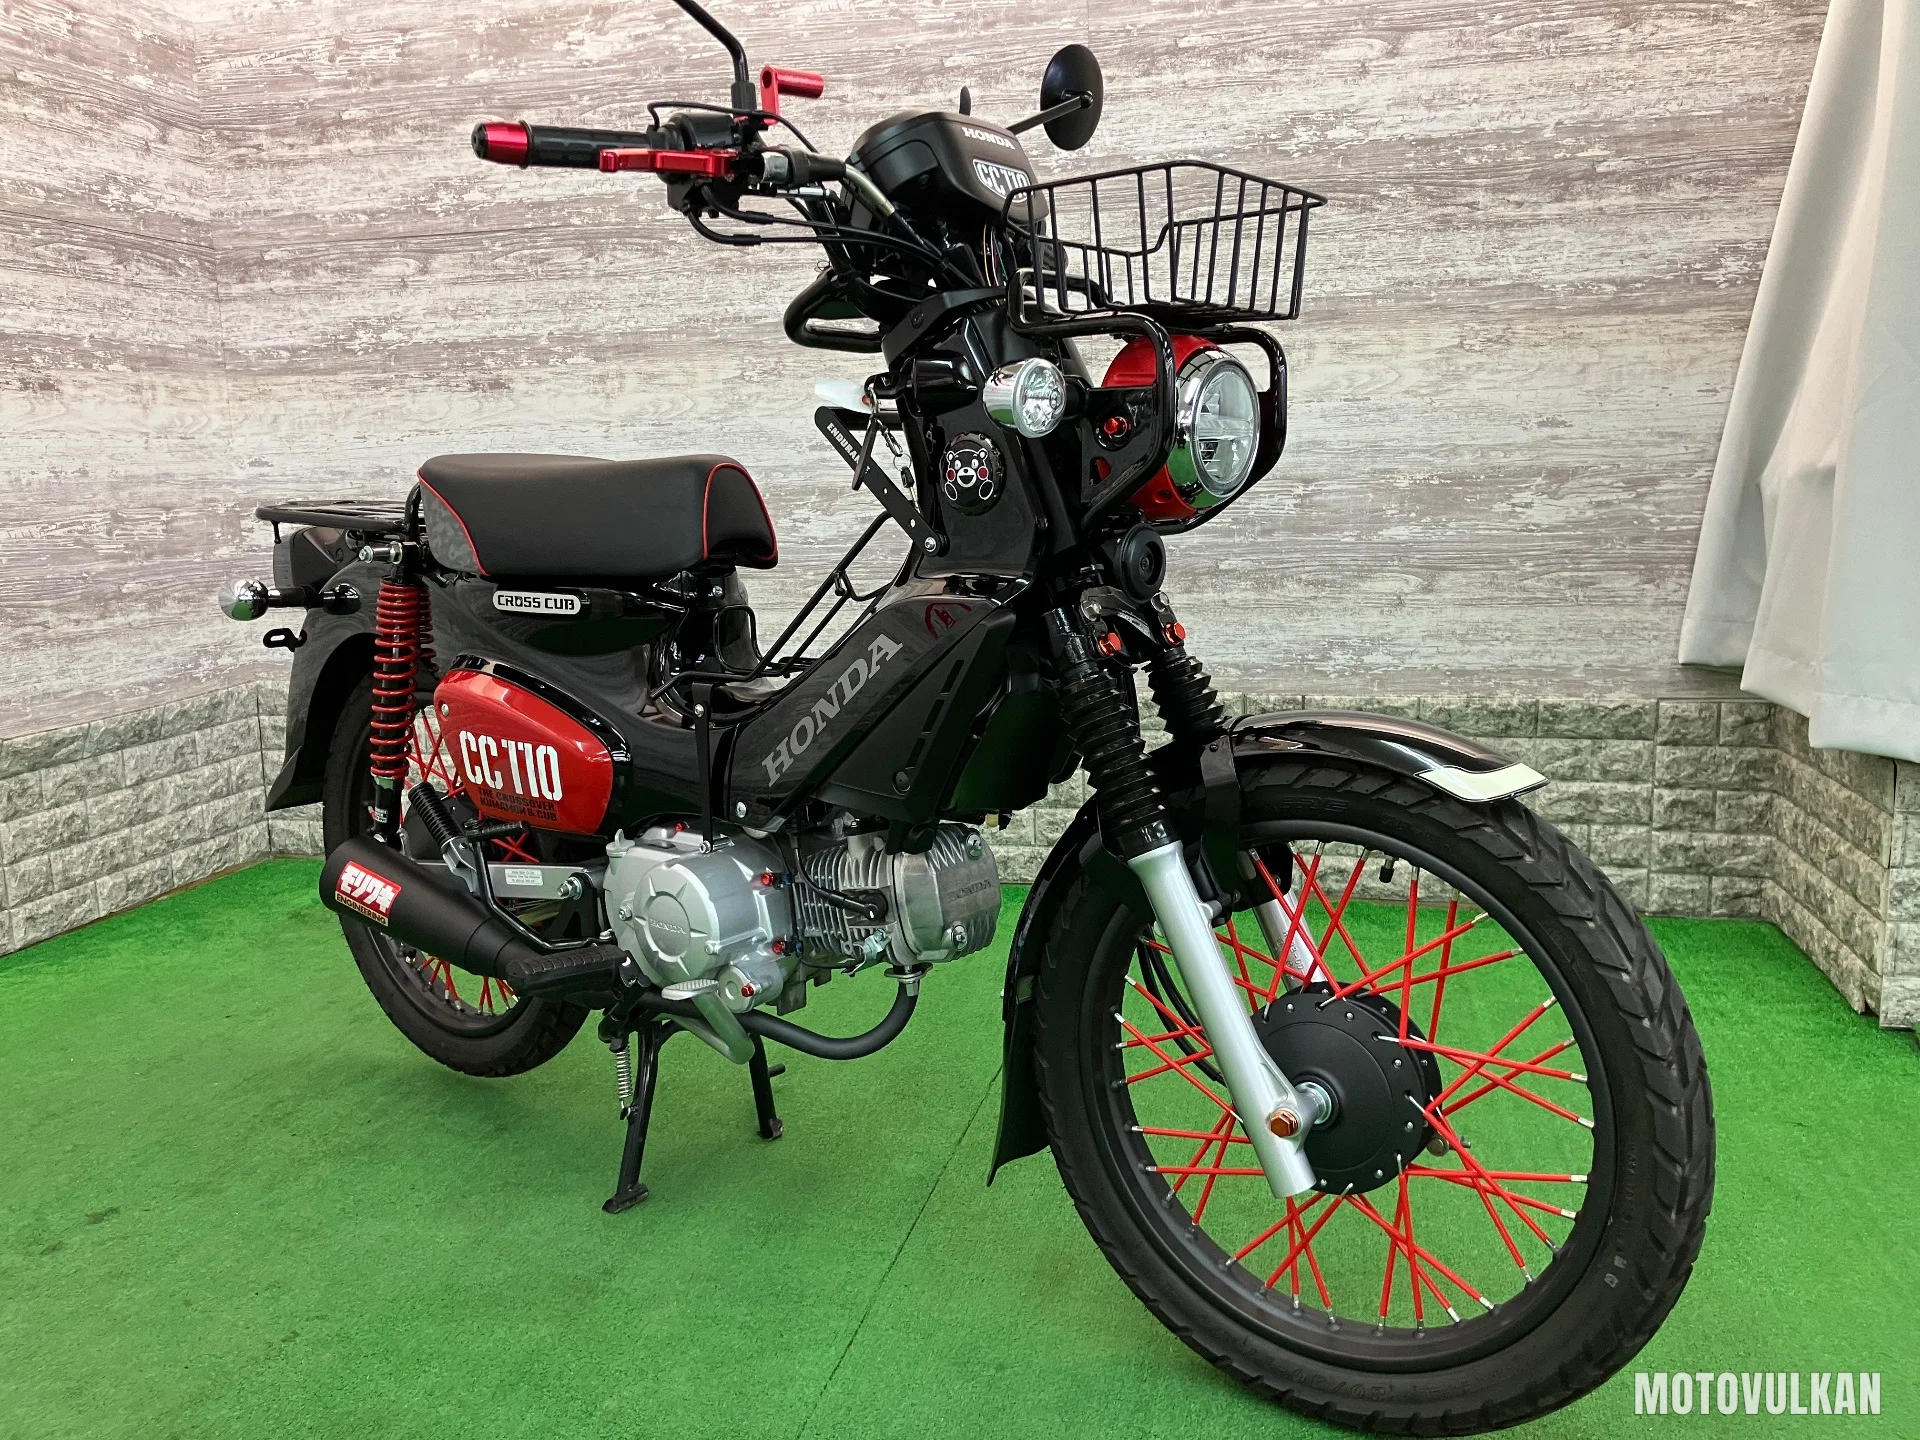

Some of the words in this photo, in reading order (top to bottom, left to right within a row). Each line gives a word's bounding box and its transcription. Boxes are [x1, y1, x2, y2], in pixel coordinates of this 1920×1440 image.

[961, 126, 1016, 150] HONDA
[497, 594, 542, 609] CROSS
[544, 597, 575, 611] CUB
[761, 633, 904, 788] HONDA
[478, 786, 494, 798] THE
[496, 791, 555, 812] CROSSOVER
[537, 810, 558, 822] CUB
[336, 893, 387, 925] ENGINEERING
[649, 918, 687, 935] HONDA
